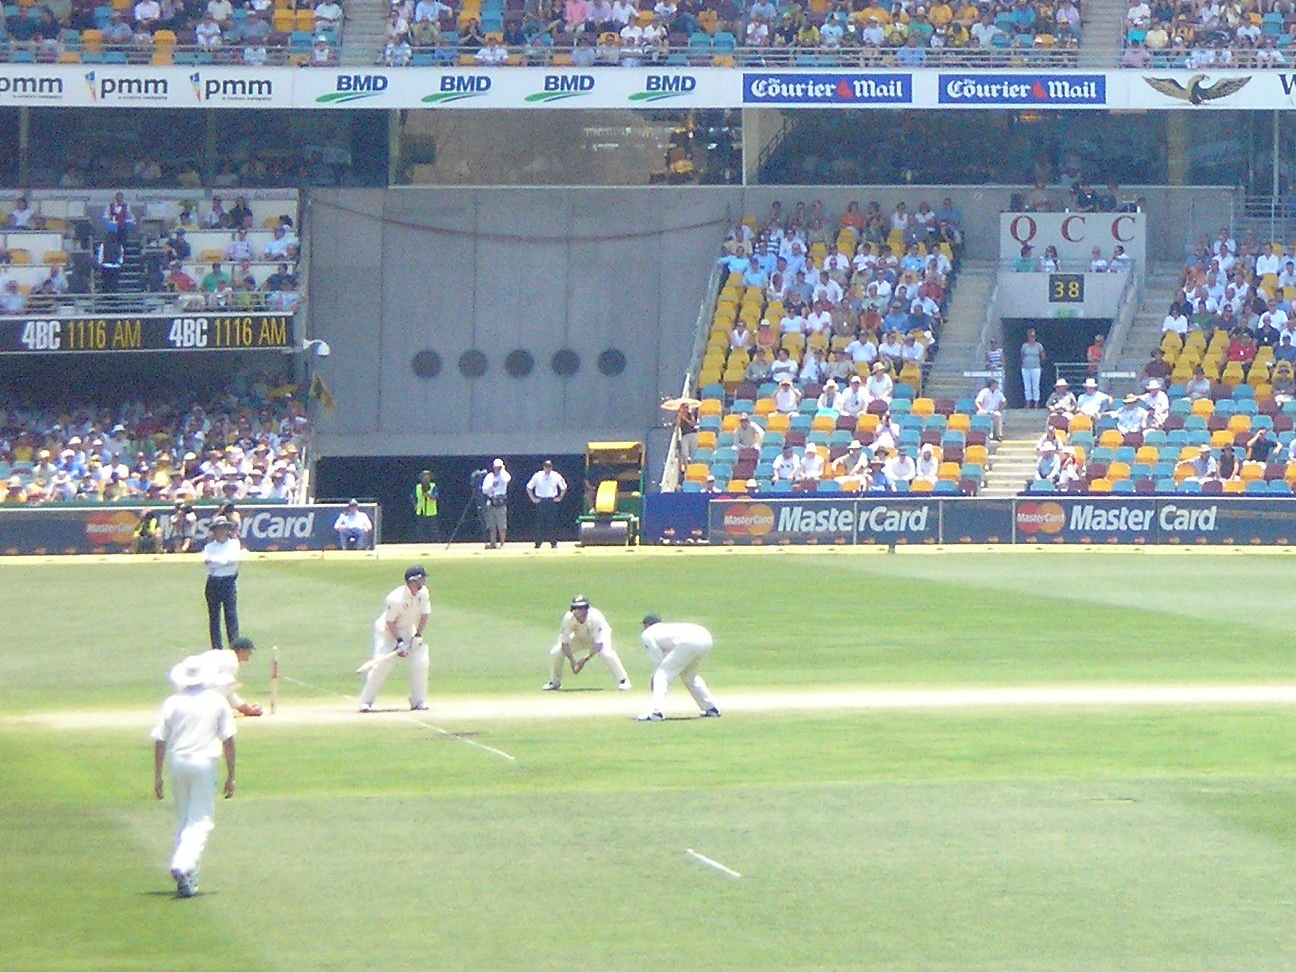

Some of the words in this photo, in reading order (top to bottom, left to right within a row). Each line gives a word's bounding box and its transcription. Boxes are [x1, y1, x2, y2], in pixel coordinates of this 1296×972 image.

[101, 78, 168, 99] pmm
[205, 79, 272, 100] pmm
[336, 75, 388, 91] BMD
[440, 75, 492, 92] BMD
[543, 75, 595, 92] BMD
[645, 75, 697, 91] BMD
[751, 78, 836, 98] Courier
[853, 79, 903, 98] Mail
[946, 79, 1032, 99] Courier
[1047, 80, 1097, 99] Mail
[1010, 215, 1037, 247] Q
[1060, 215, 1086, 243] C
[1110, 215, 1136, 243] C
[1054, 281, 1080, 298] 38
[22, 320, 61, 350] 4BC
[68, 321, 106, 349] 1116
[112, 319, 142, 348] AM
[168, 318, 208, 348] 4BC
[214, 317, 252, 347] 1116
[259, 317, 287, 346] AM
[724, 514, 774, 526] MasterCard
[778, 505, 929, 532] MasterCard
[1017, 513, 1065, 524] MasterCard
